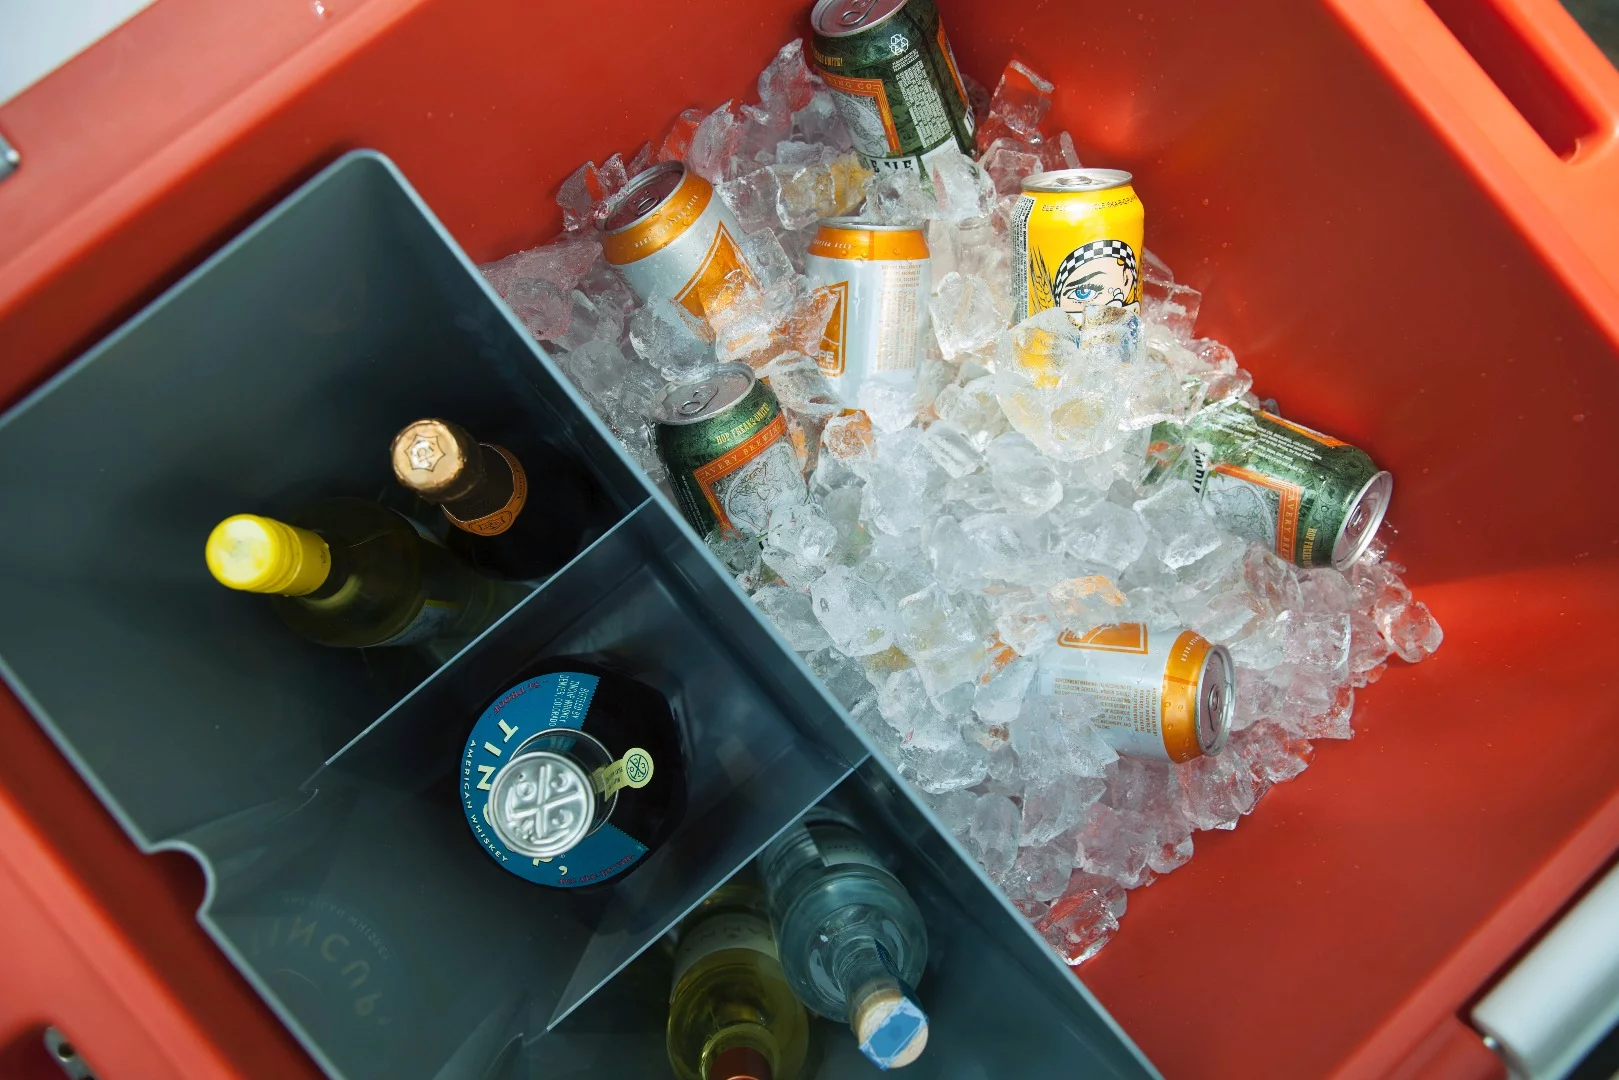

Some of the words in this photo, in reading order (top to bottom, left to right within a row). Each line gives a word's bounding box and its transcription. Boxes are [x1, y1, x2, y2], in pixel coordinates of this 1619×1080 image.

[715, 432, 730, 445] HOP
[728, 417, 756, 439] FREAKS
[753, 401, 770, 421] UNITE!
[703, 454, 738, 477] AVERY
[742, 422, 780, 455] BREWING
[1283, 495, 1295, 533] AVERY
[1305, 527, 1317, 540] HOP
[462, 739, 476, 809] AMERICAN
[470, 814, 508, 862] WHISKEY
